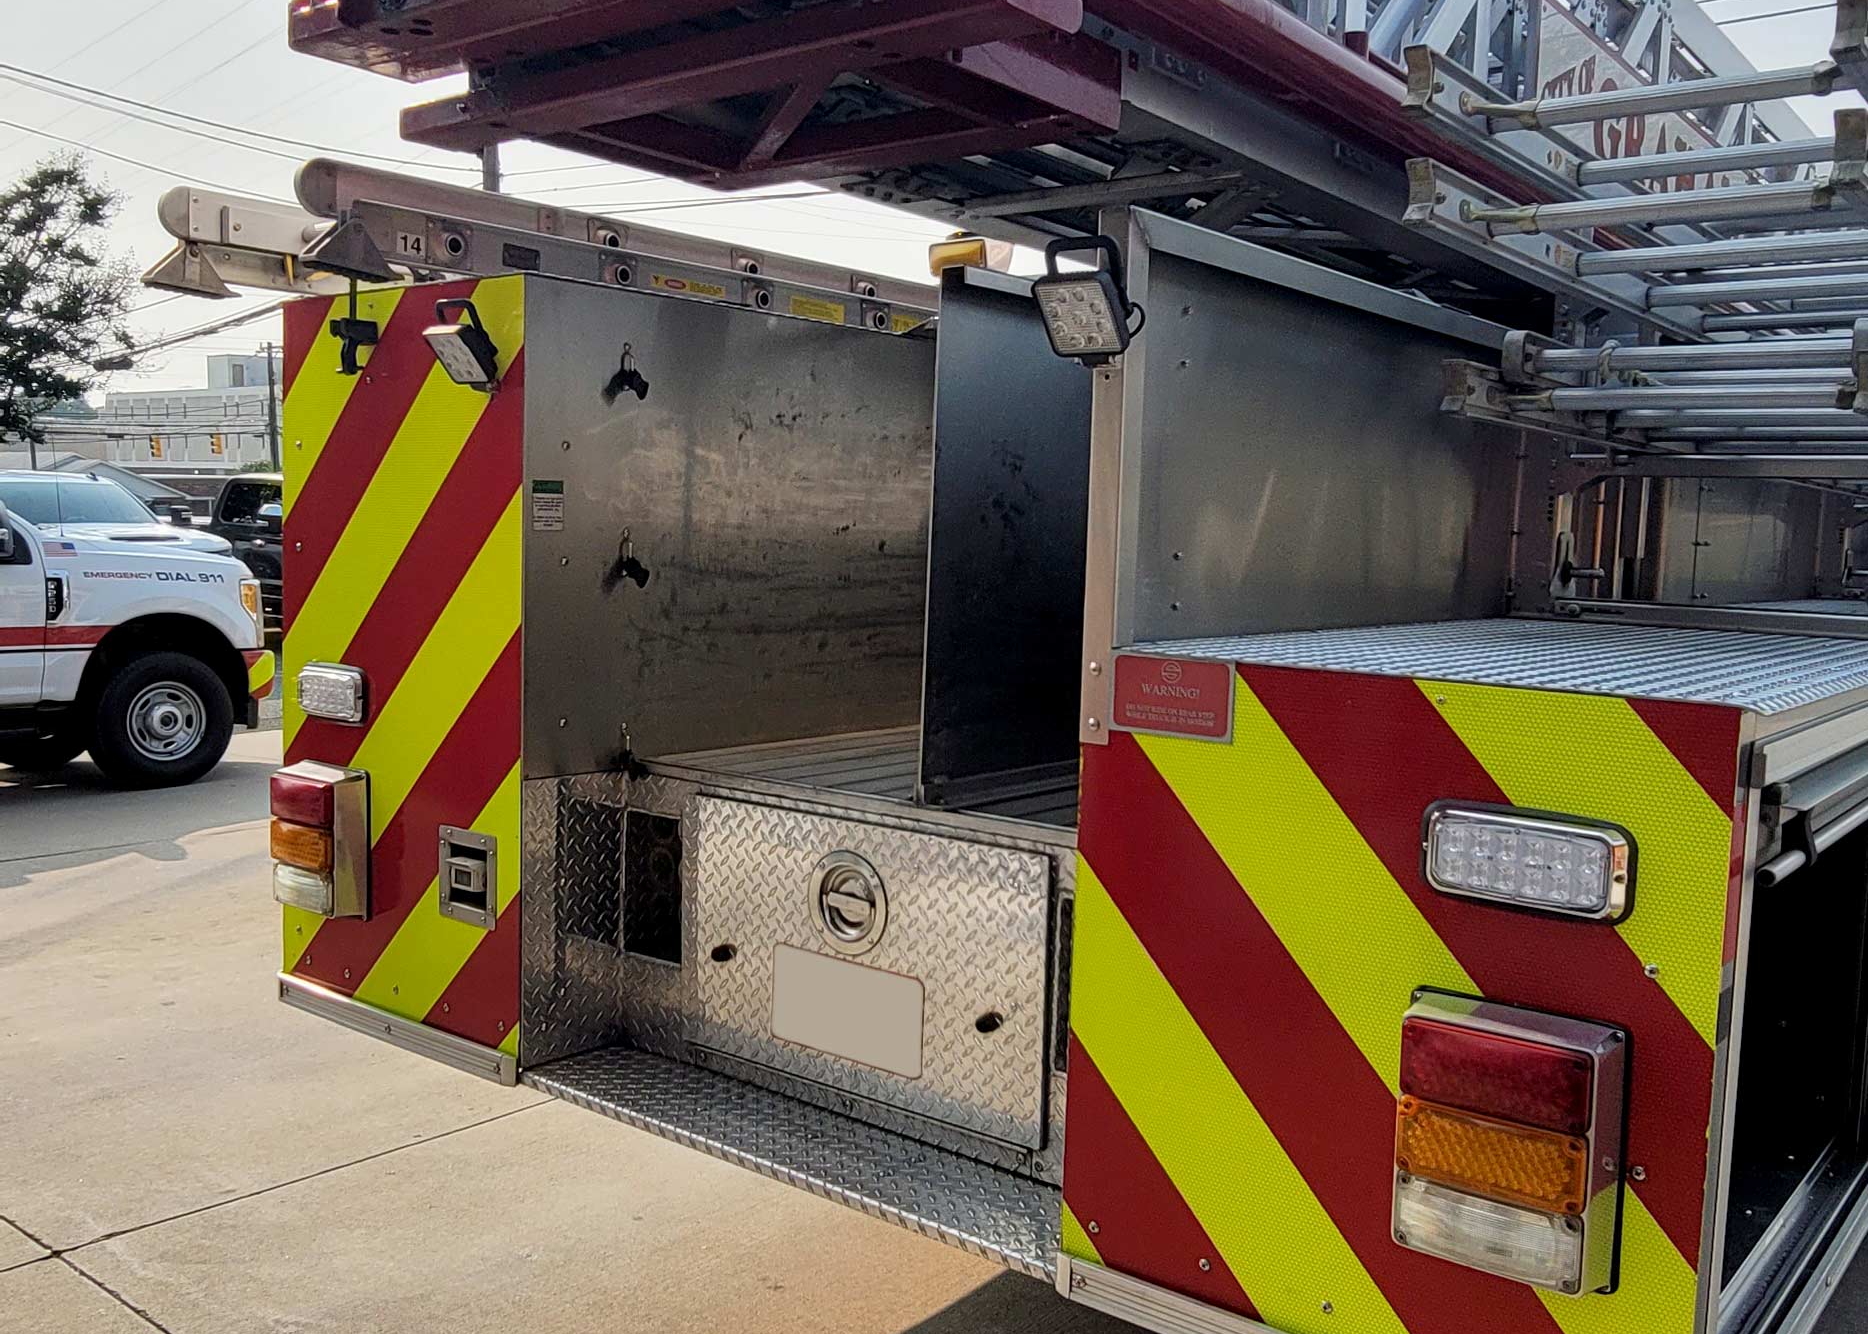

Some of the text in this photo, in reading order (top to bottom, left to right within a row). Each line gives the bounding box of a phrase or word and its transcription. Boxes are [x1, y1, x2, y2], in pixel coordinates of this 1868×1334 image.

[400, 234, 422, 255] 14
[83, 571, 225, 583] EMERGENCY DIAL 911
[1141, 683, 1200, 699] WARNING!
